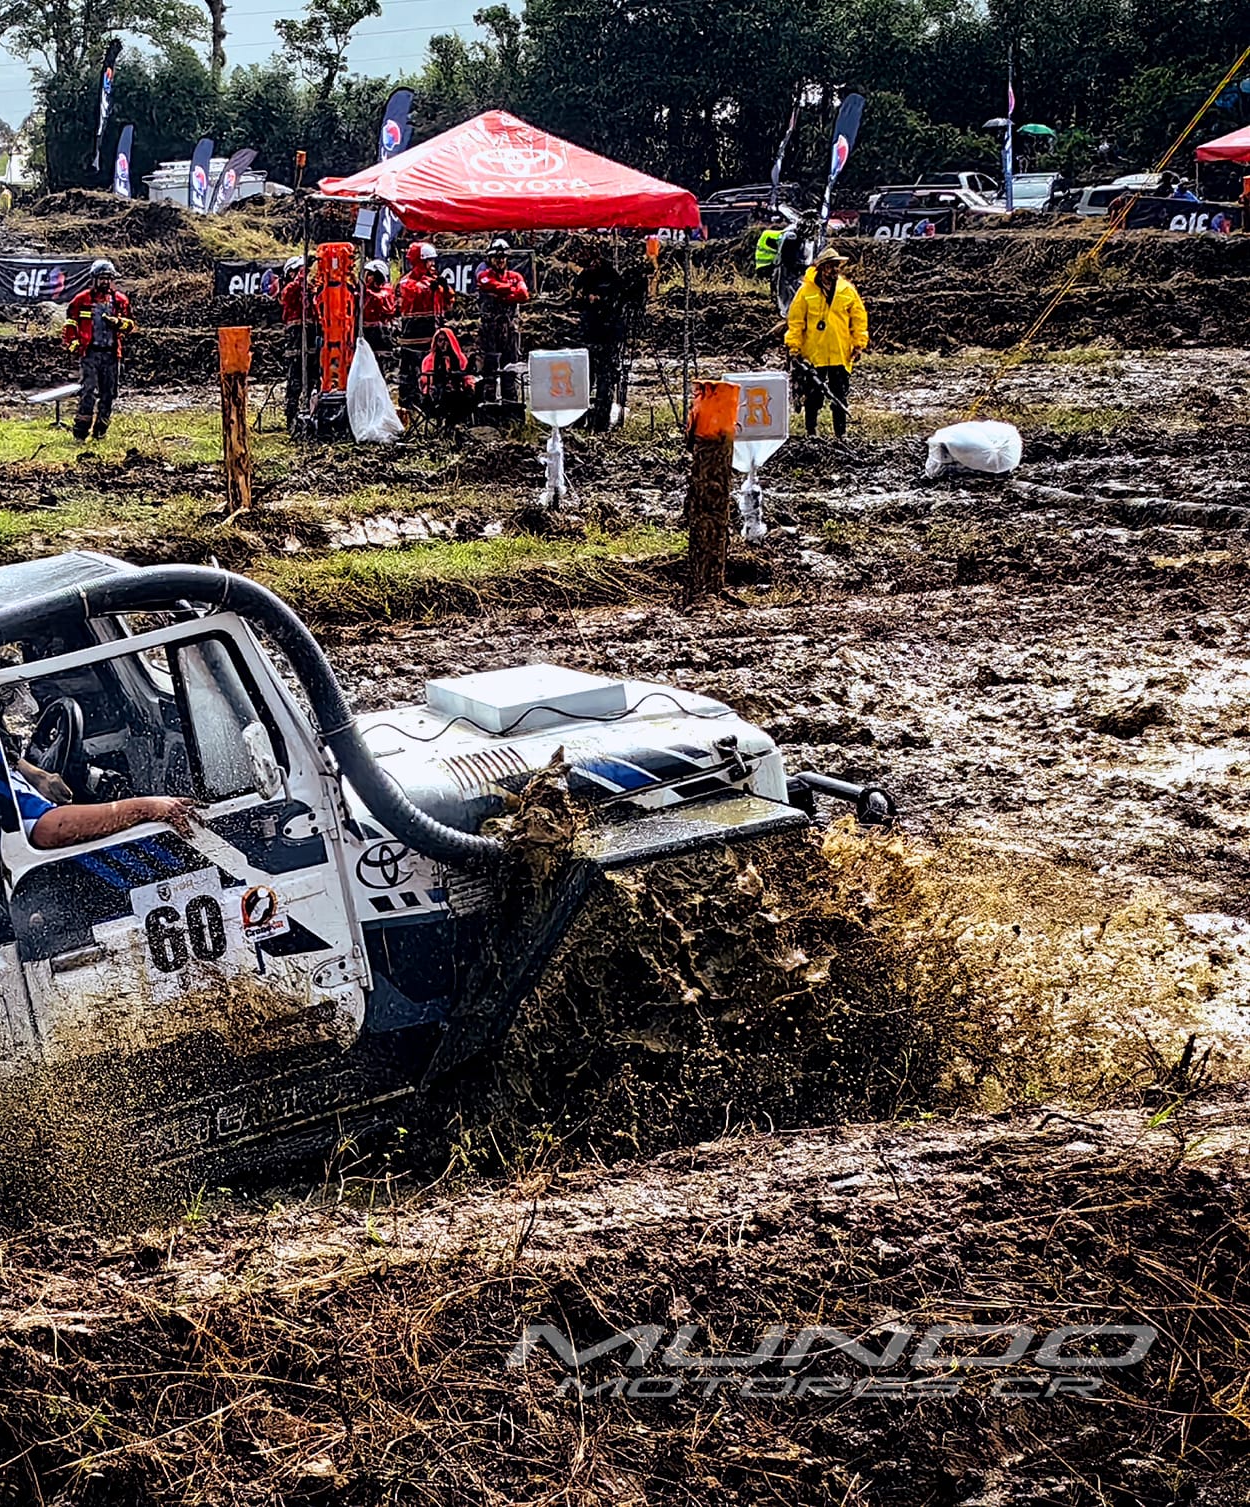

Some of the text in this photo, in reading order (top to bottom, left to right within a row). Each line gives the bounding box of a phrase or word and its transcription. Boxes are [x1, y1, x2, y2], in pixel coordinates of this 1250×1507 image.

[462, 177, 593, 194] TOYOTA
[13, 268, 50, 298] elf
[229, 272, 261, 296] elf
[744, 386, 772, 426] R
[145, 894, 228, 973] 60
